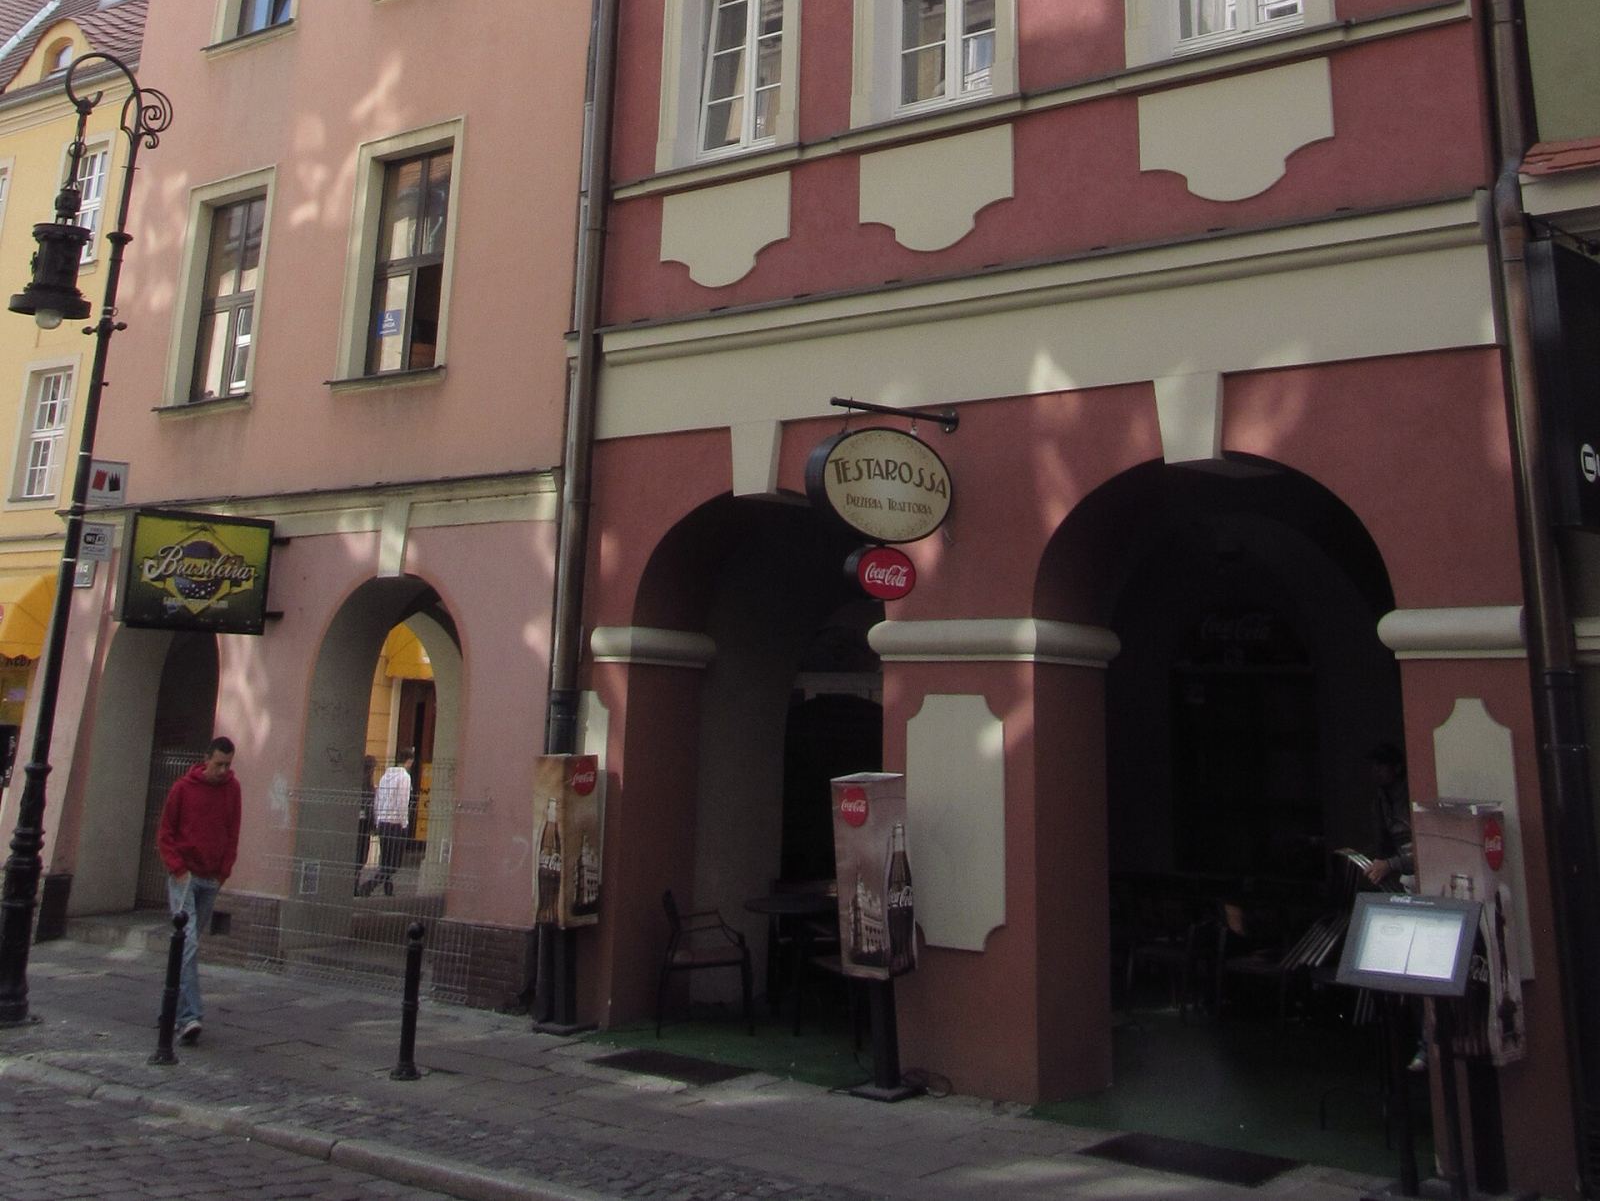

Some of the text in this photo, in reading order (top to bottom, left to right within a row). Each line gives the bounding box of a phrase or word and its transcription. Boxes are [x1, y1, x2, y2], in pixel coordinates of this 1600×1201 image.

[829, 457, 947, 499] TESTAROSSA
[846, 493, 932, 515] PIZZERIA TRATTORIA
[143, 545, 252, 579] Brasileira
